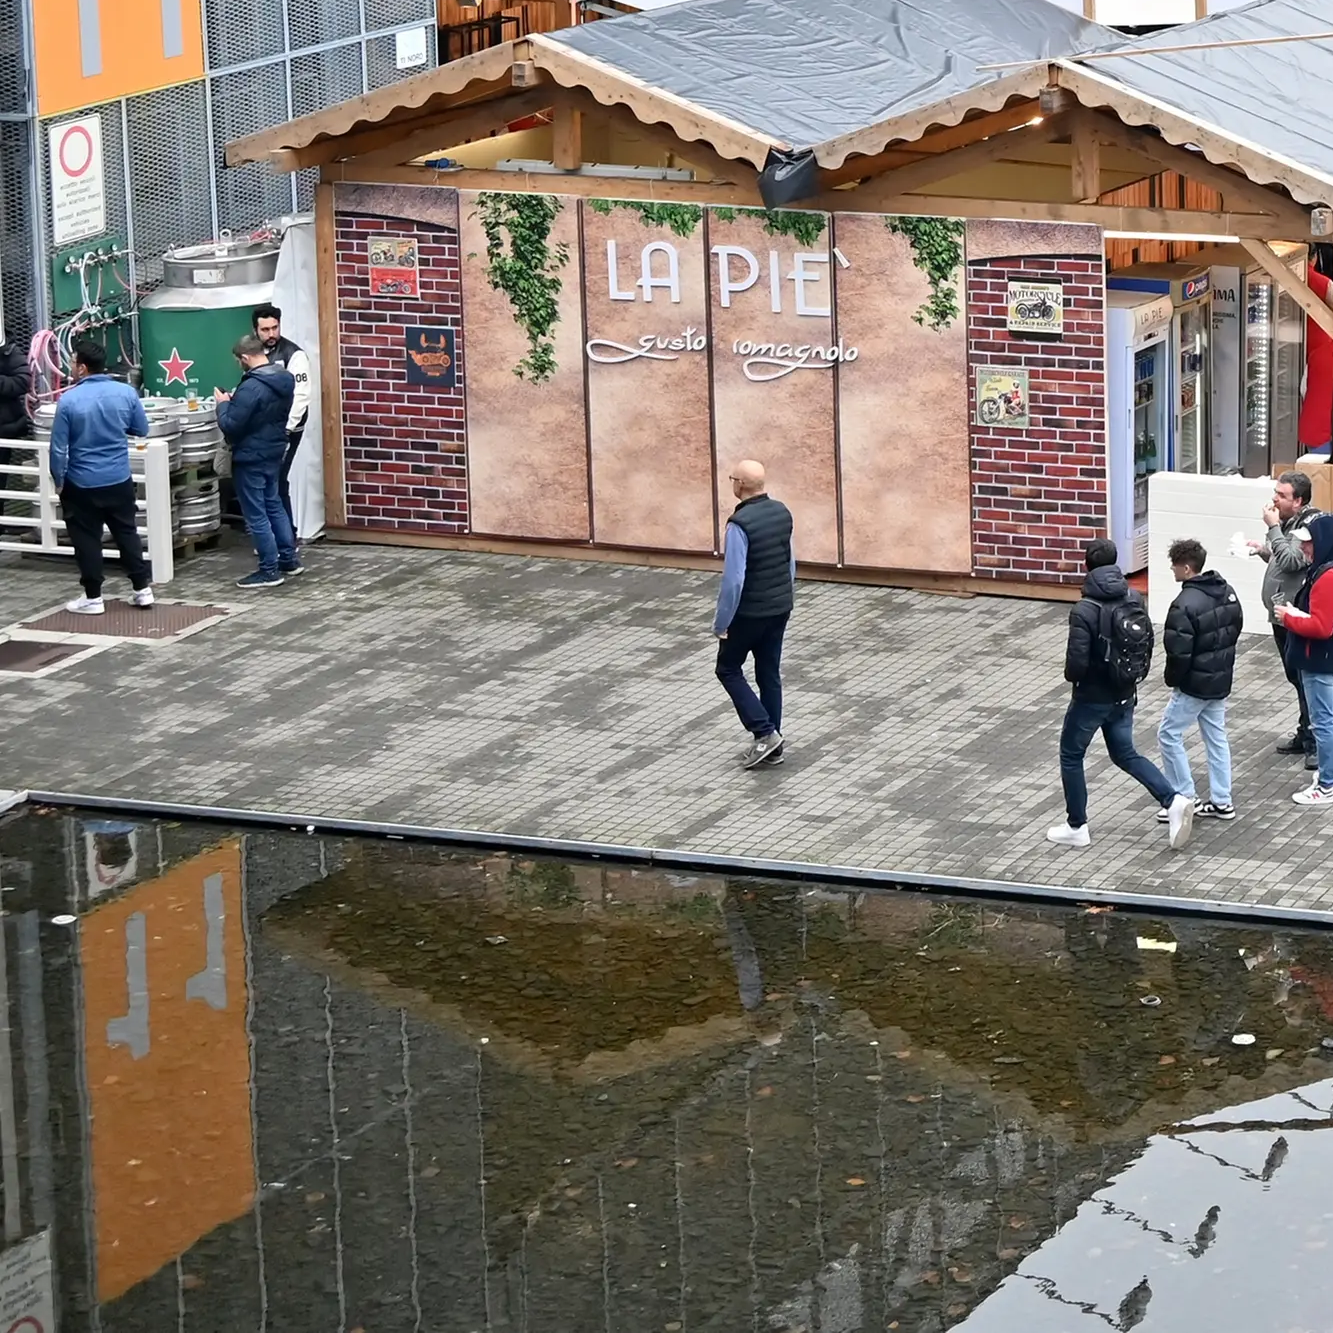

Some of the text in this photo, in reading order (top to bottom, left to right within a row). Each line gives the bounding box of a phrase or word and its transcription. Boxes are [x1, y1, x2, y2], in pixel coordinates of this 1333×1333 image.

[606, 239, 681, 303] LA
[586, 326, 859, 382] gusto romagnolo
